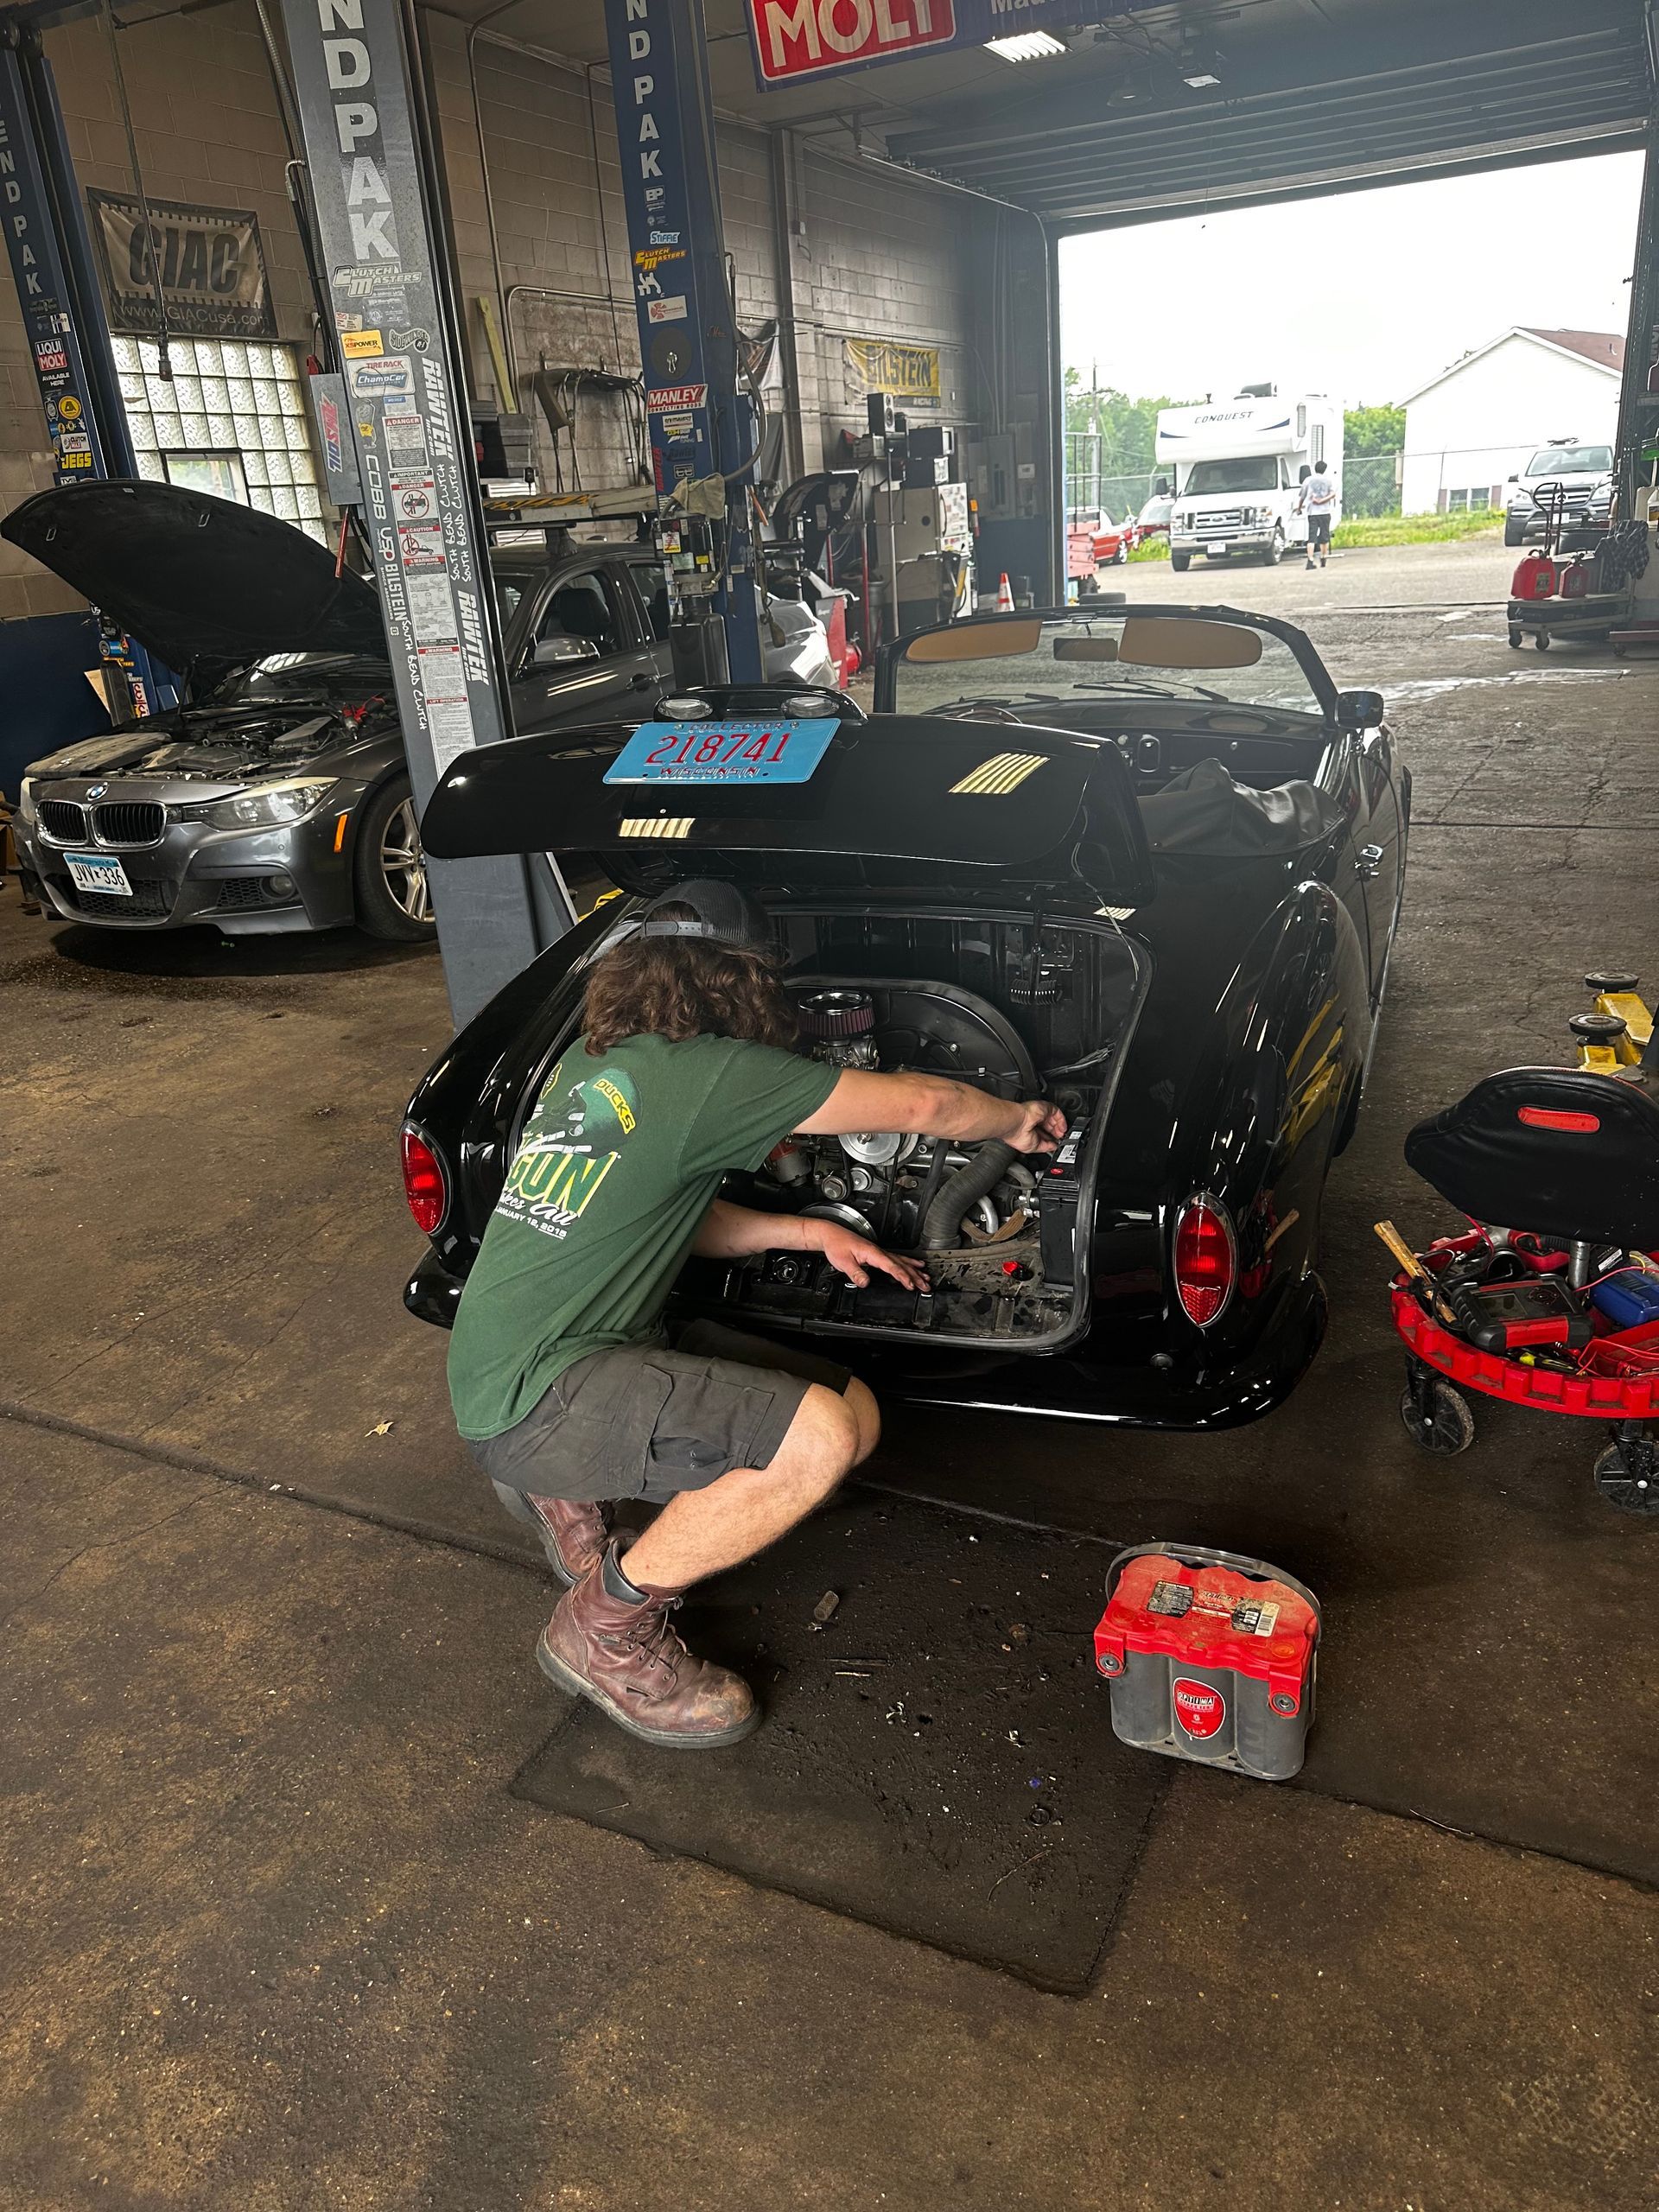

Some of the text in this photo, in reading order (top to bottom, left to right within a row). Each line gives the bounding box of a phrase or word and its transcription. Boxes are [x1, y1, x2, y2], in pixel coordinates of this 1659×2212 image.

[130, 222, 240, 294] GIAC
[334, 266, 393, 285] CLUTCH
[350, 273, 421, 296] MASTERS
[36, 340, 62, 356] LIQUI
[39, 353, 65, 369] MOLY
[383, 359, 404, 369] RACK
[357, 374, 406, 384] ChampCar
[648, 387, 699, 407] MANLEY
[422, 357, 454, 461] RAWTEK
[1194, 410, 1254, 424] CONQUEST
[61, 452, 92, 469] JEGS
[365, 454, 387, 520] COBB
[385, 563, 408, 621] BILSTEIN
[457, 589, 490, 686] RAWTEK
[690, 722, 784, 731] COLLECTOR
[644, 732, 792, 766] 218741
[661, 766, 760, 777] WISCONSIN
[594, 1077, 636, 1134] DUCKS
[539, 1221, 568, 1237] 2015
[1177, 1690, 1214, 1706] OPTIMA
